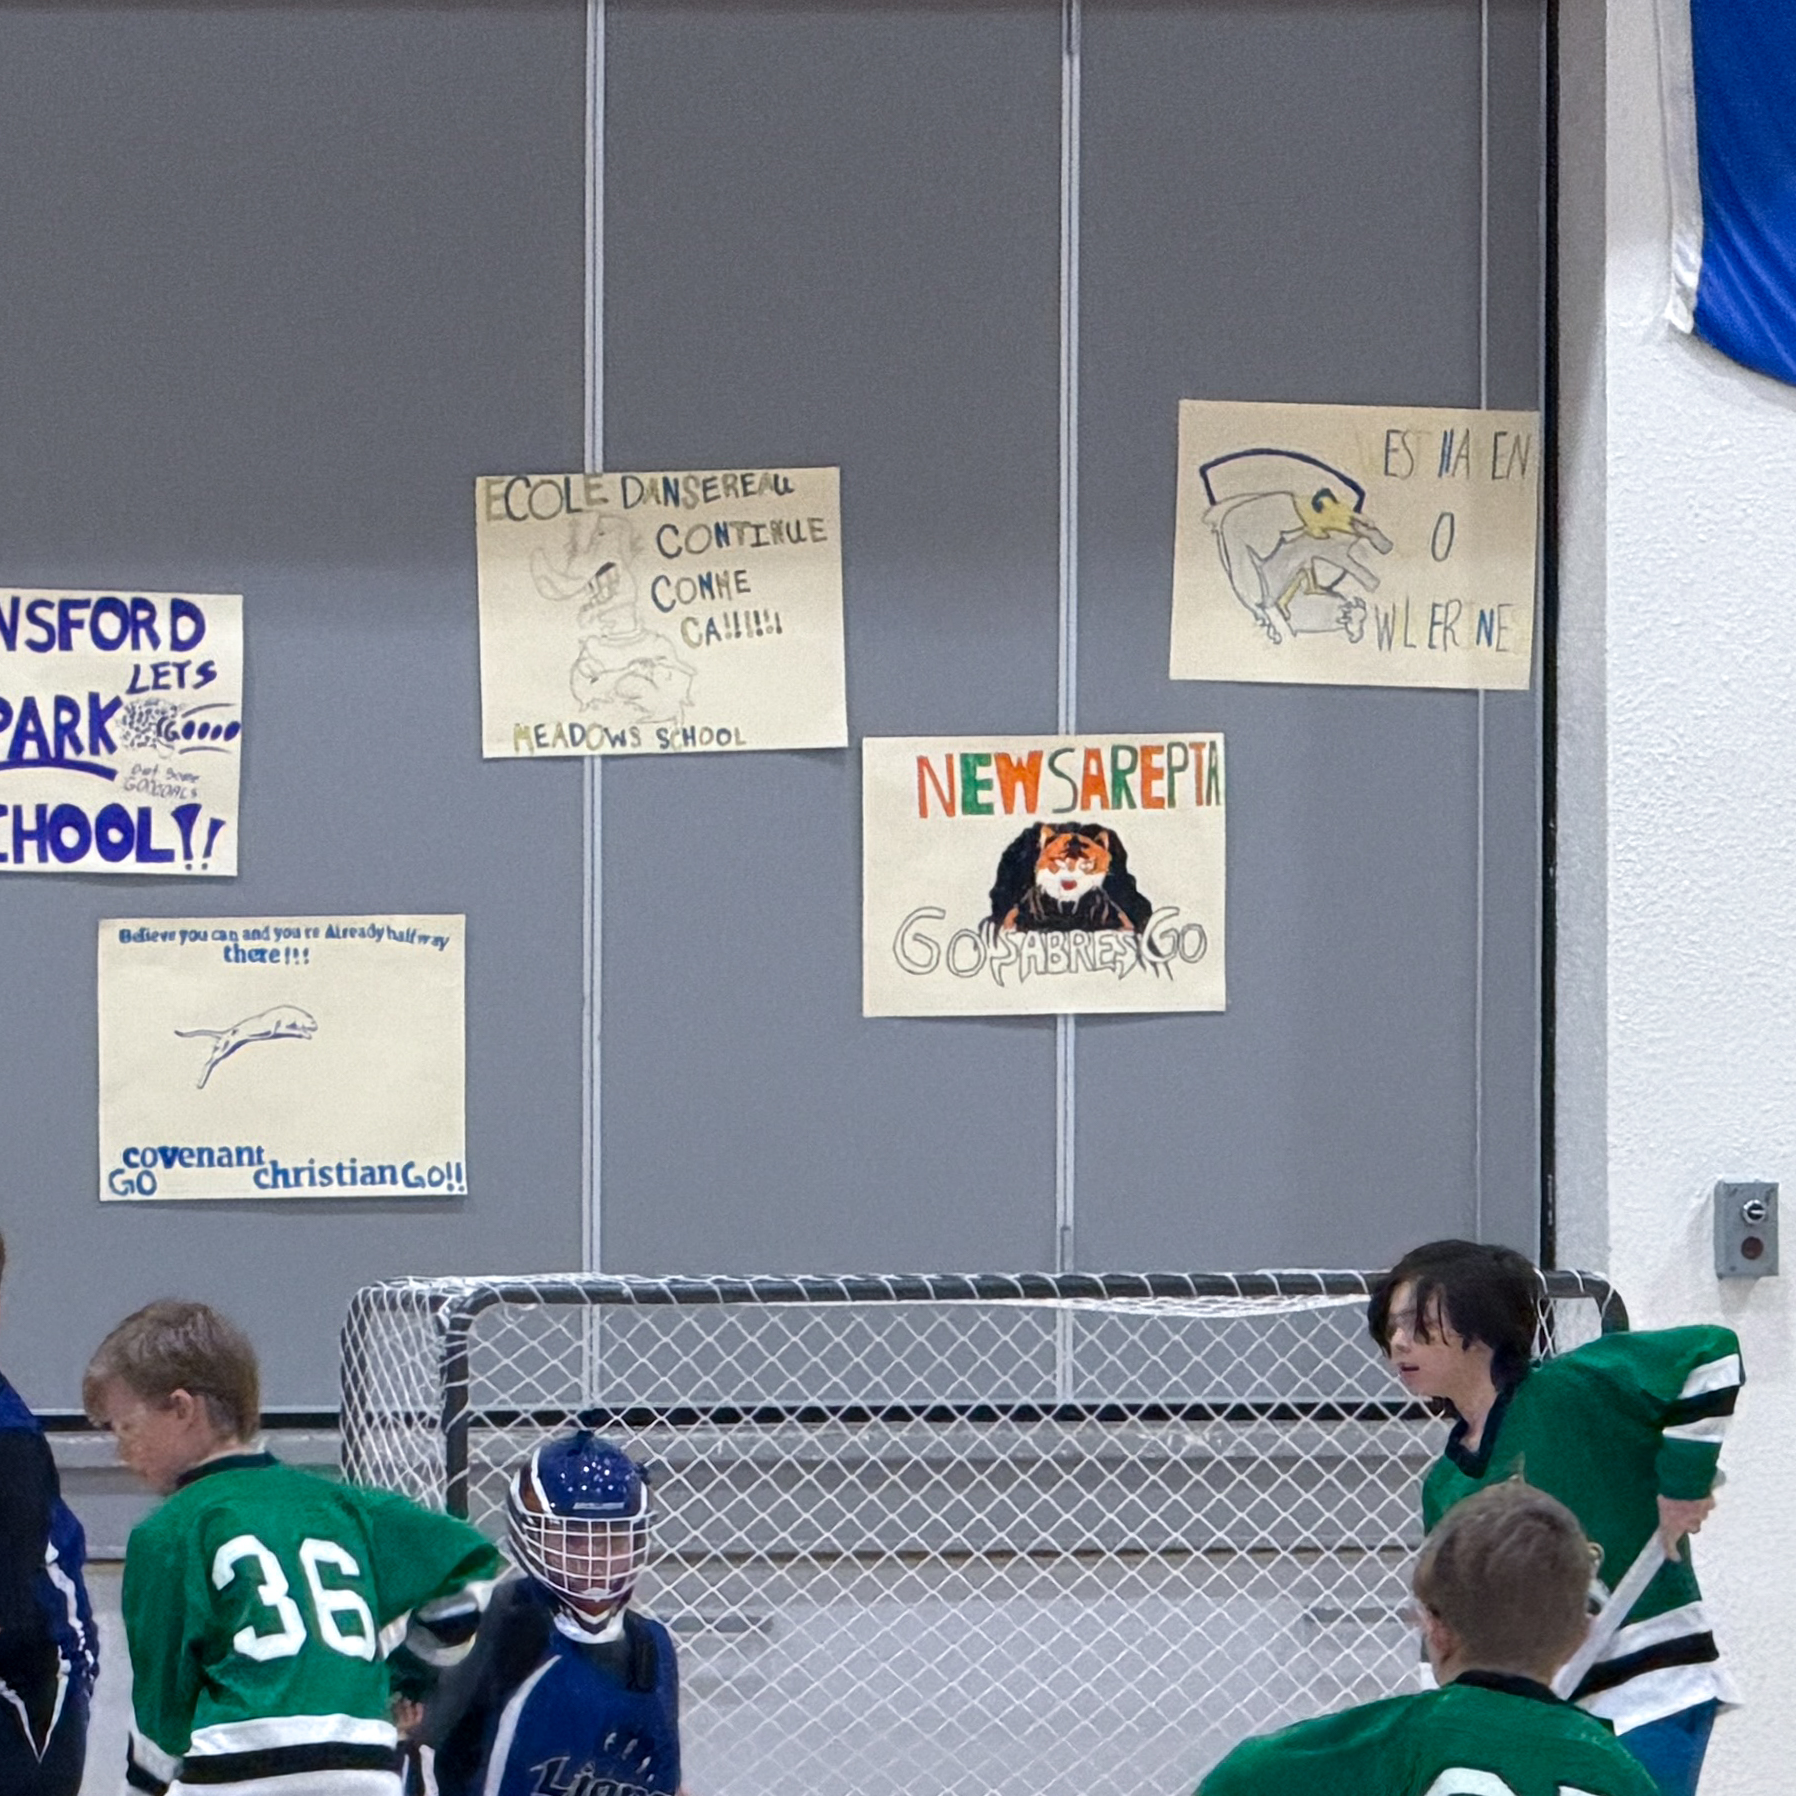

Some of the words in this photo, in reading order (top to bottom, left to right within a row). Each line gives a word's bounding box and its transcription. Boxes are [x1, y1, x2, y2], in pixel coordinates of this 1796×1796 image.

[1437, 428, 1532, 481] HAEN
[485, 472, 609, 522] ECOLE
[621, 472, 795, 510] DANSEREAU
[656, 517, 828, 559] CONTINUE
[125, 659, 218, 695] LETS
[513, 722, 643, 754] MEADOWS
[655, 723, 747, 751] SCHOOL
[916, 750, 1044, 818] NEW
[1047, 741, 1222, 814] SAREPTA
[118, 927, 176, 943] Believe
[179, 929, 208, 946] you
[211, 929, 239, 942] can
[242, 926, 270, 941] and
[107, 1168, 158, 1196] GO
[253, 1157, 399, 1190] christian
[212, 1532, 379, 1662] 36
